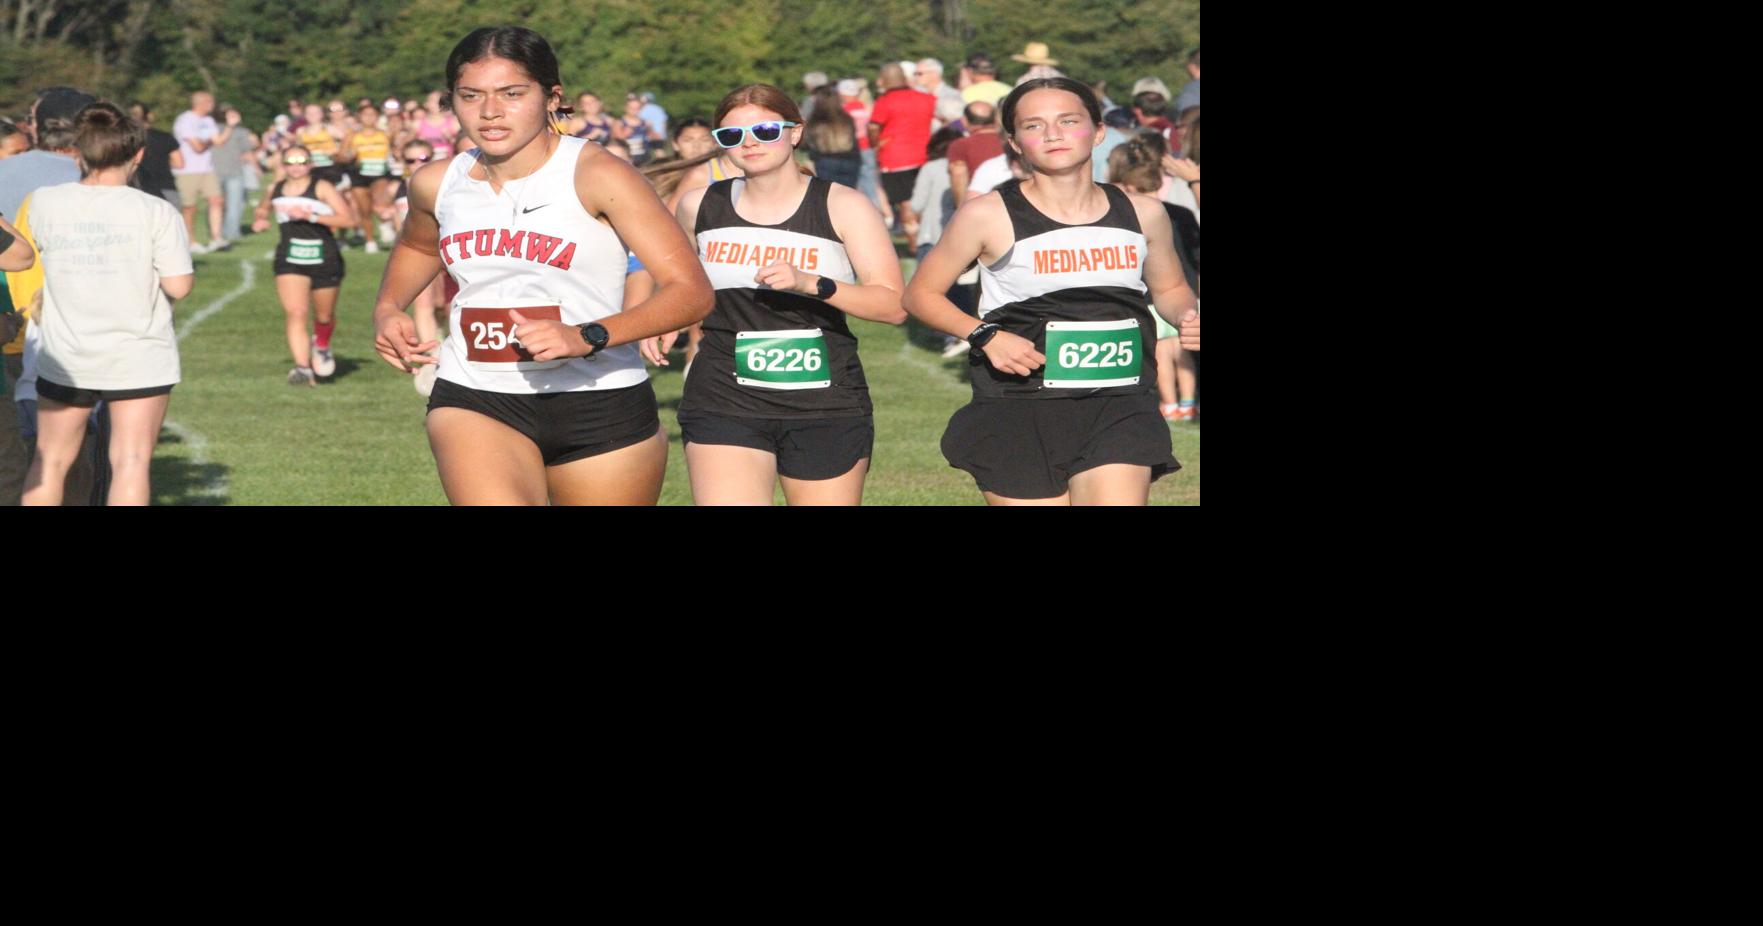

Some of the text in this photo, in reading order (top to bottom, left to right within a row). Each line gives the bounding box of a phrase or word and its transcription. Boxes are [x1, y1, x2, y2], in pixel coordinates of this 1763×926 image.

[1034, 245, 1138, 274] MEDIAPOLIS
[747, 348, 821, 371] 6226
[1058, 340, 1133, 369] 6225
